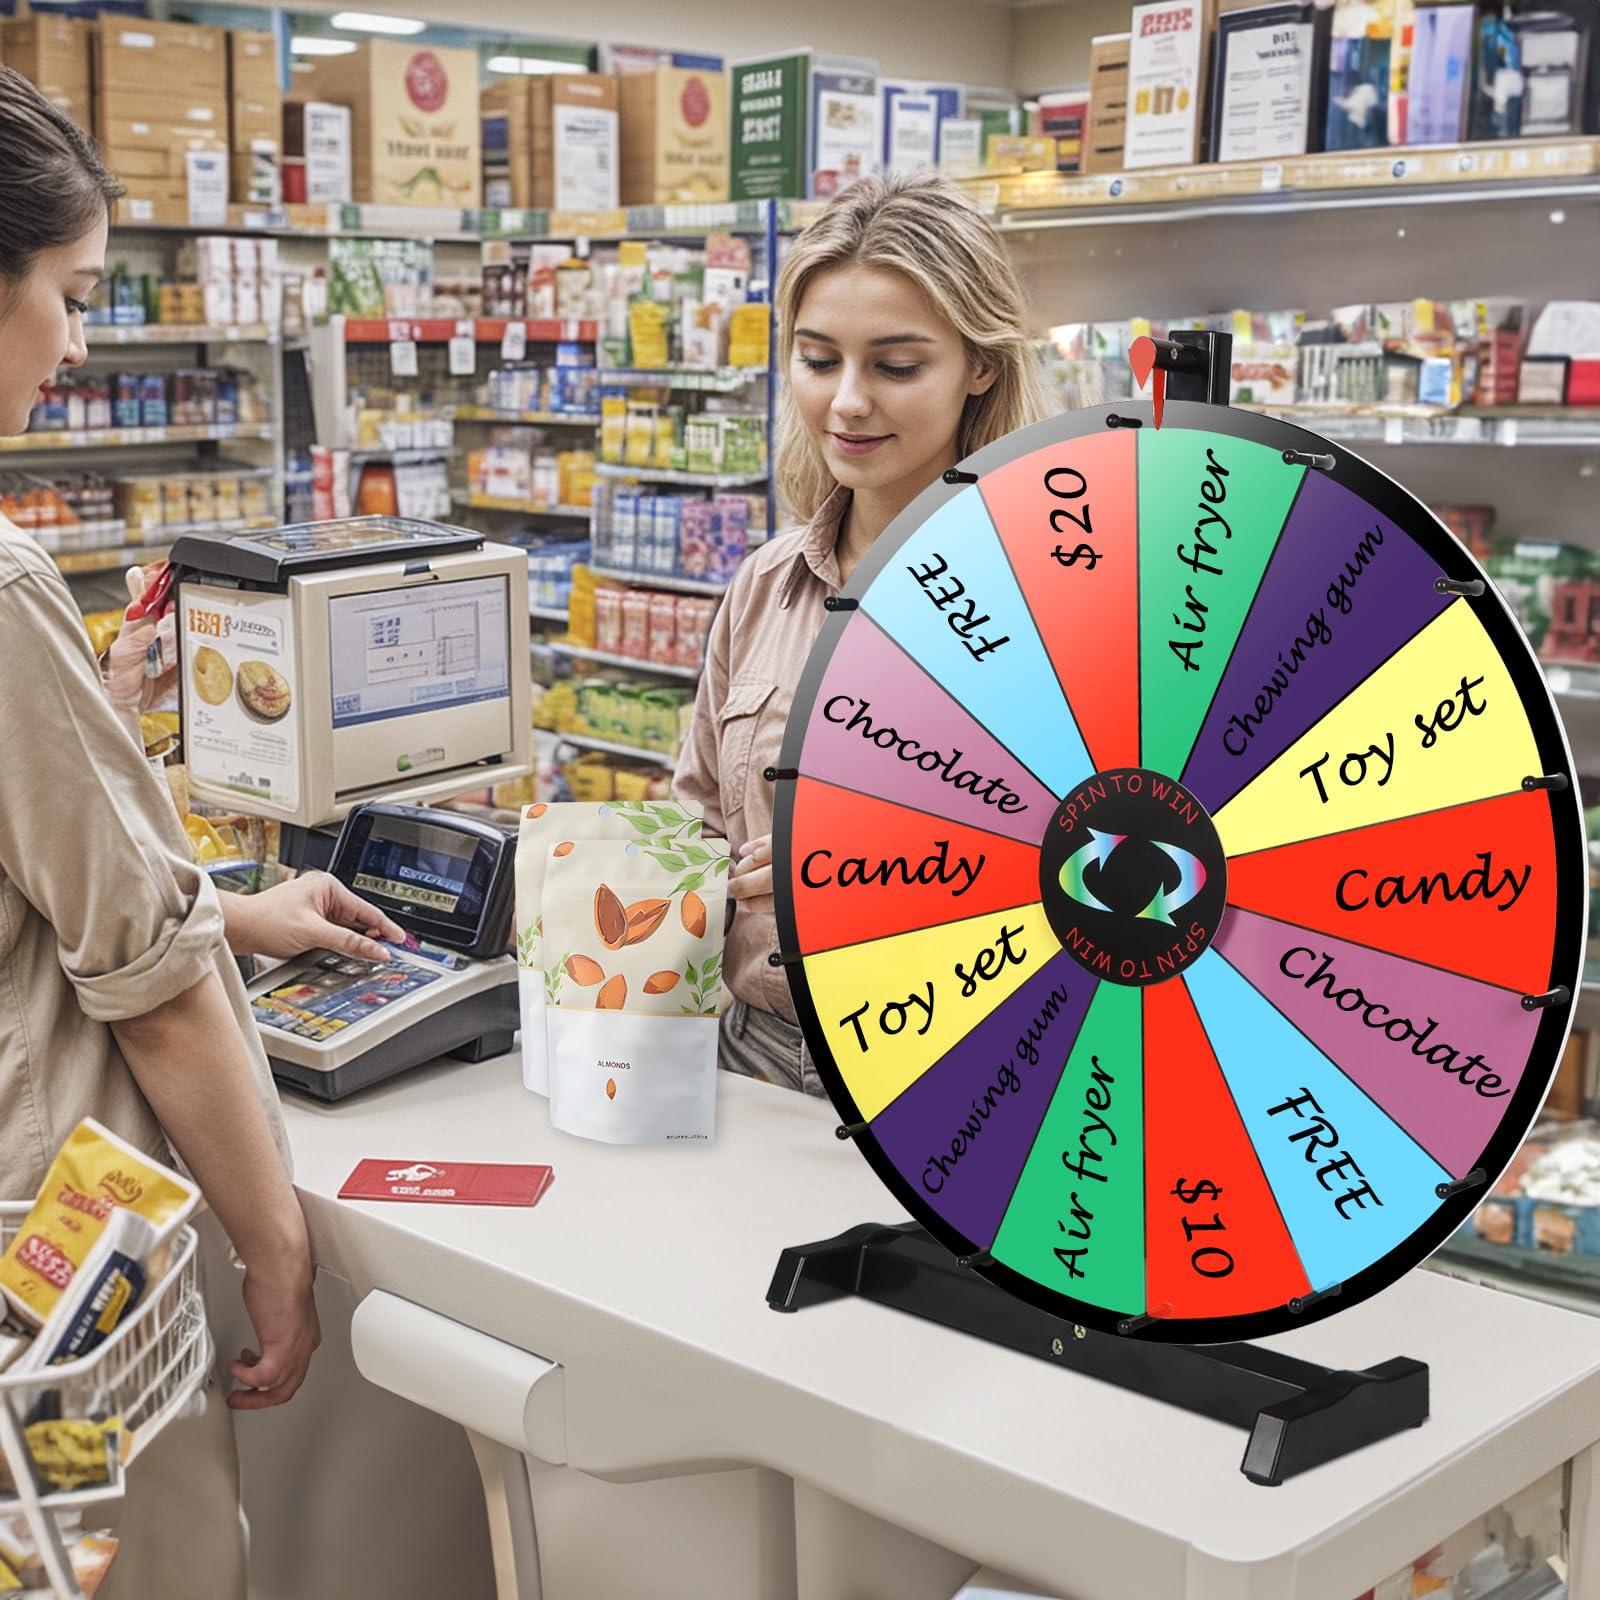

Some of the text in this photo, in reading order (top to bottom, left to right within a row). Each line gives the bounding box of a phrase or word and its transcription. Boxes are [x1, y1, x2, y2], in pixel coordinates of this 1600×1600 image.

[1044, 467, 1103, 570] $20
[1168, 448, 1232, 672] Air fryer
[906, 553, 1010, 662] FREE
[1223, 525, 1385, 757] Chewing gum
[823, 695, 1028, 814] Chocolate
[1299, 676, 1487, 804] Toy set
[1059, 775, 1199, 832] SPIN TO WIN
[801, 840, 986, 897] Candy
[1335, 851, 1532, 912] Candy
[839, 925, 1027, 1053] Toy set
[1066, 921, 1206, 978] SPIN TO WIN
[597, 1060, 631, 1069] ALMONDS
[1279, 946, 1511, 1098] Chocolate
[922, 984, 1068, 1194] Chewing gum
[1053, 1055, 1117, 1279] Air fryer
[1266, 1087, 1384, 1221] FREE
[1170, 1177, 1235, 1279] $10
